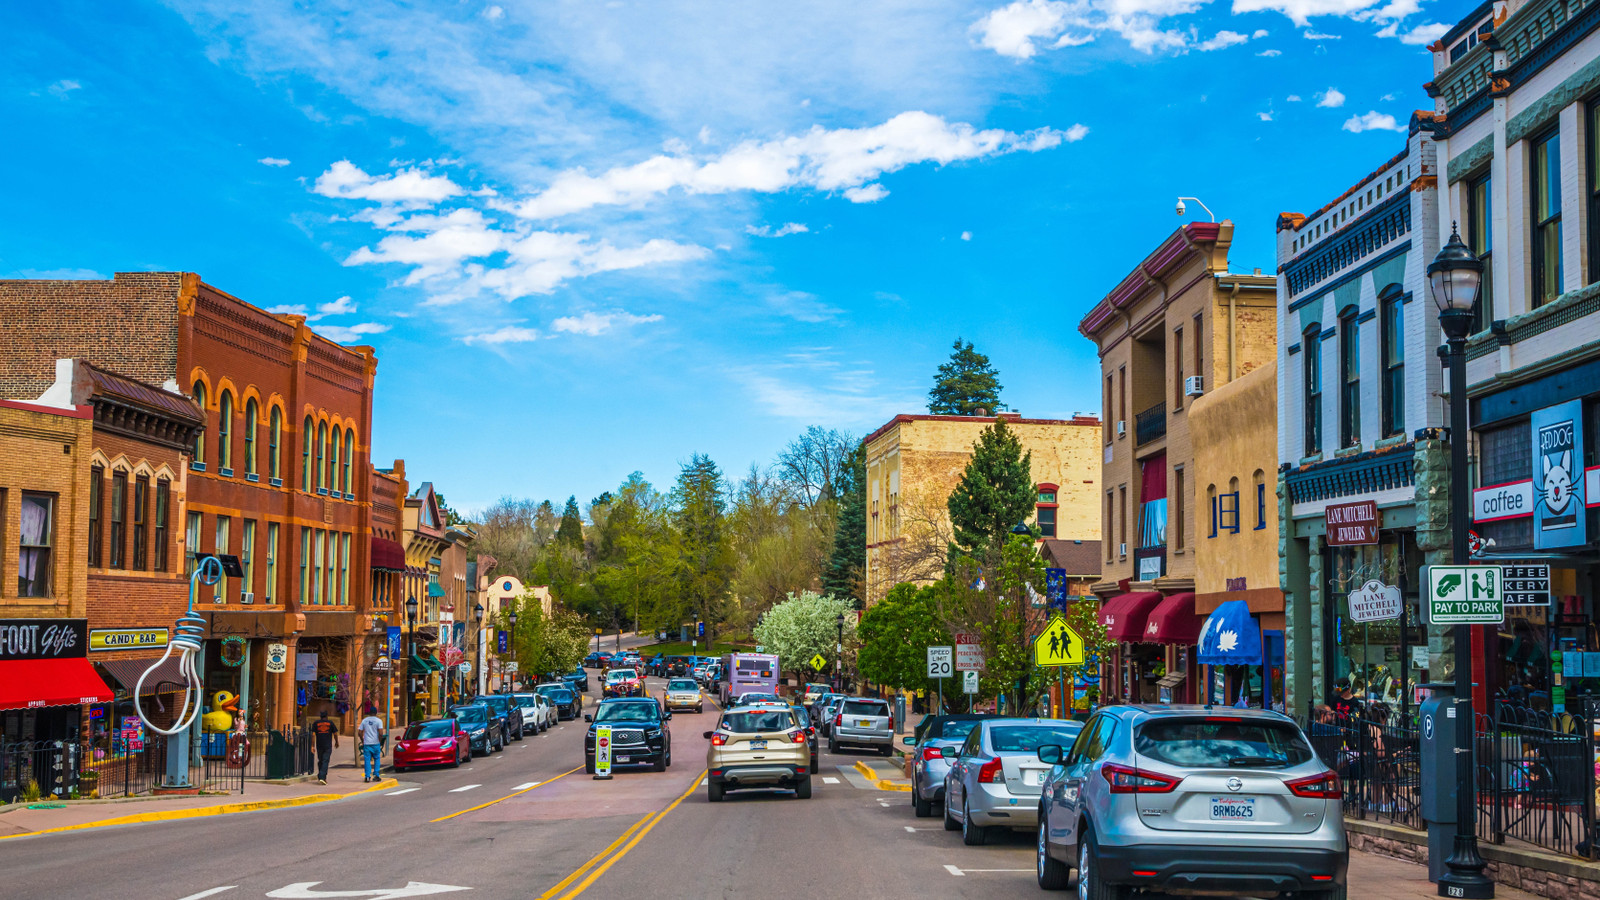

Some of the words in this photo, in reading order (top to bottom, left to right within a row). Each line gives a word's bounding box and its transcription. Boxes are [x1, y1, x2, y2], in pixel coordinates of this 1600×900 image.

[1554, 426, 1573, 446] DOG
[1483, 491, 1523, 514] coffee
[1327, 507, 1342, 524] LANE
[1342, 504, 1375, 523] MITCHELL
[1338, 526, 1366, 541] JEWELERS
[1363, 592, 1386, 602] LANE
[1353, 600, 1398, 612] MITCHELL
[1434, 602, 1453, 613] PAY
[1456, 602, 1469, 613] TO
[1472, 602, 1499, 612] PARK
[1358, 608, 1396, 619] JEWELERS
[41, 624, 78, 656] Gifts
[104, 634, 135, 645] CANDY
[139, 634, 156, 644] BAR
[930, 662, 950, 674] 20
[1213, 805, 1253, 817] 8RMB625
